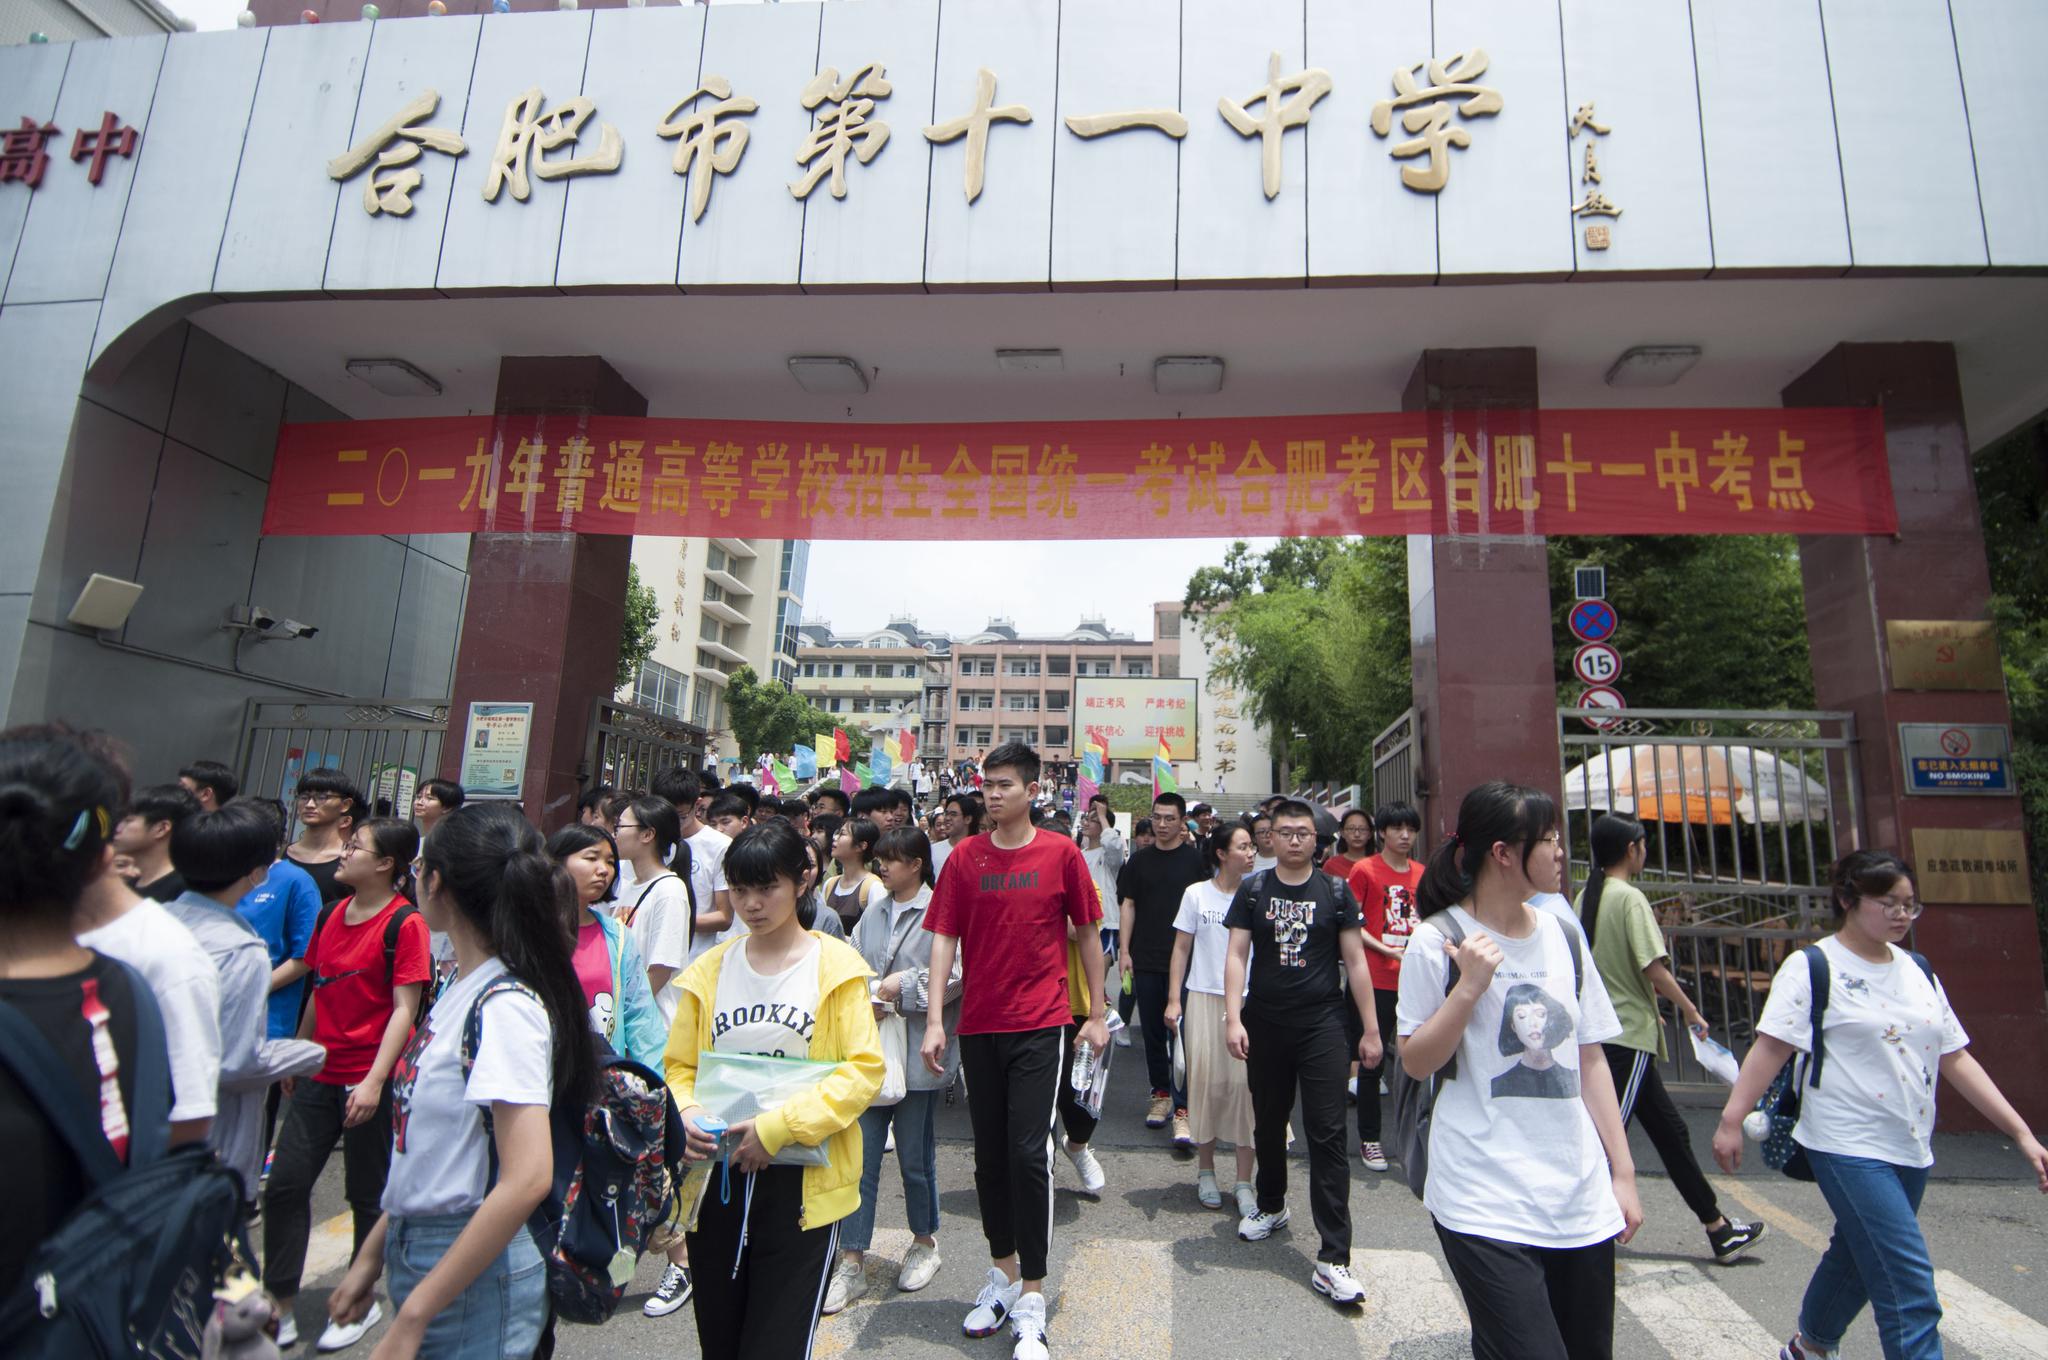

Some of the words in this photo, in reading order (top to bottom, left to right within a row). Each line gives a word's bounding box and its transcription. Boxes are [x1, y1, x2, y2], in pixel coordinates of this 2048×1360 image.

[328, 48, 1503, 223] 合肥市第十一中学
[0, 110, 139, 189] 高中
[1584, 655, 1612, 675] 15
[1929, 772, 1944, 780] NO
[1946, 772, 1991, 780] SMOKING
[1265, 897, 1316, 924] JUST
[1274, 919, 1308, 944] DO
[1280, 943, 1306, 967] IT.
